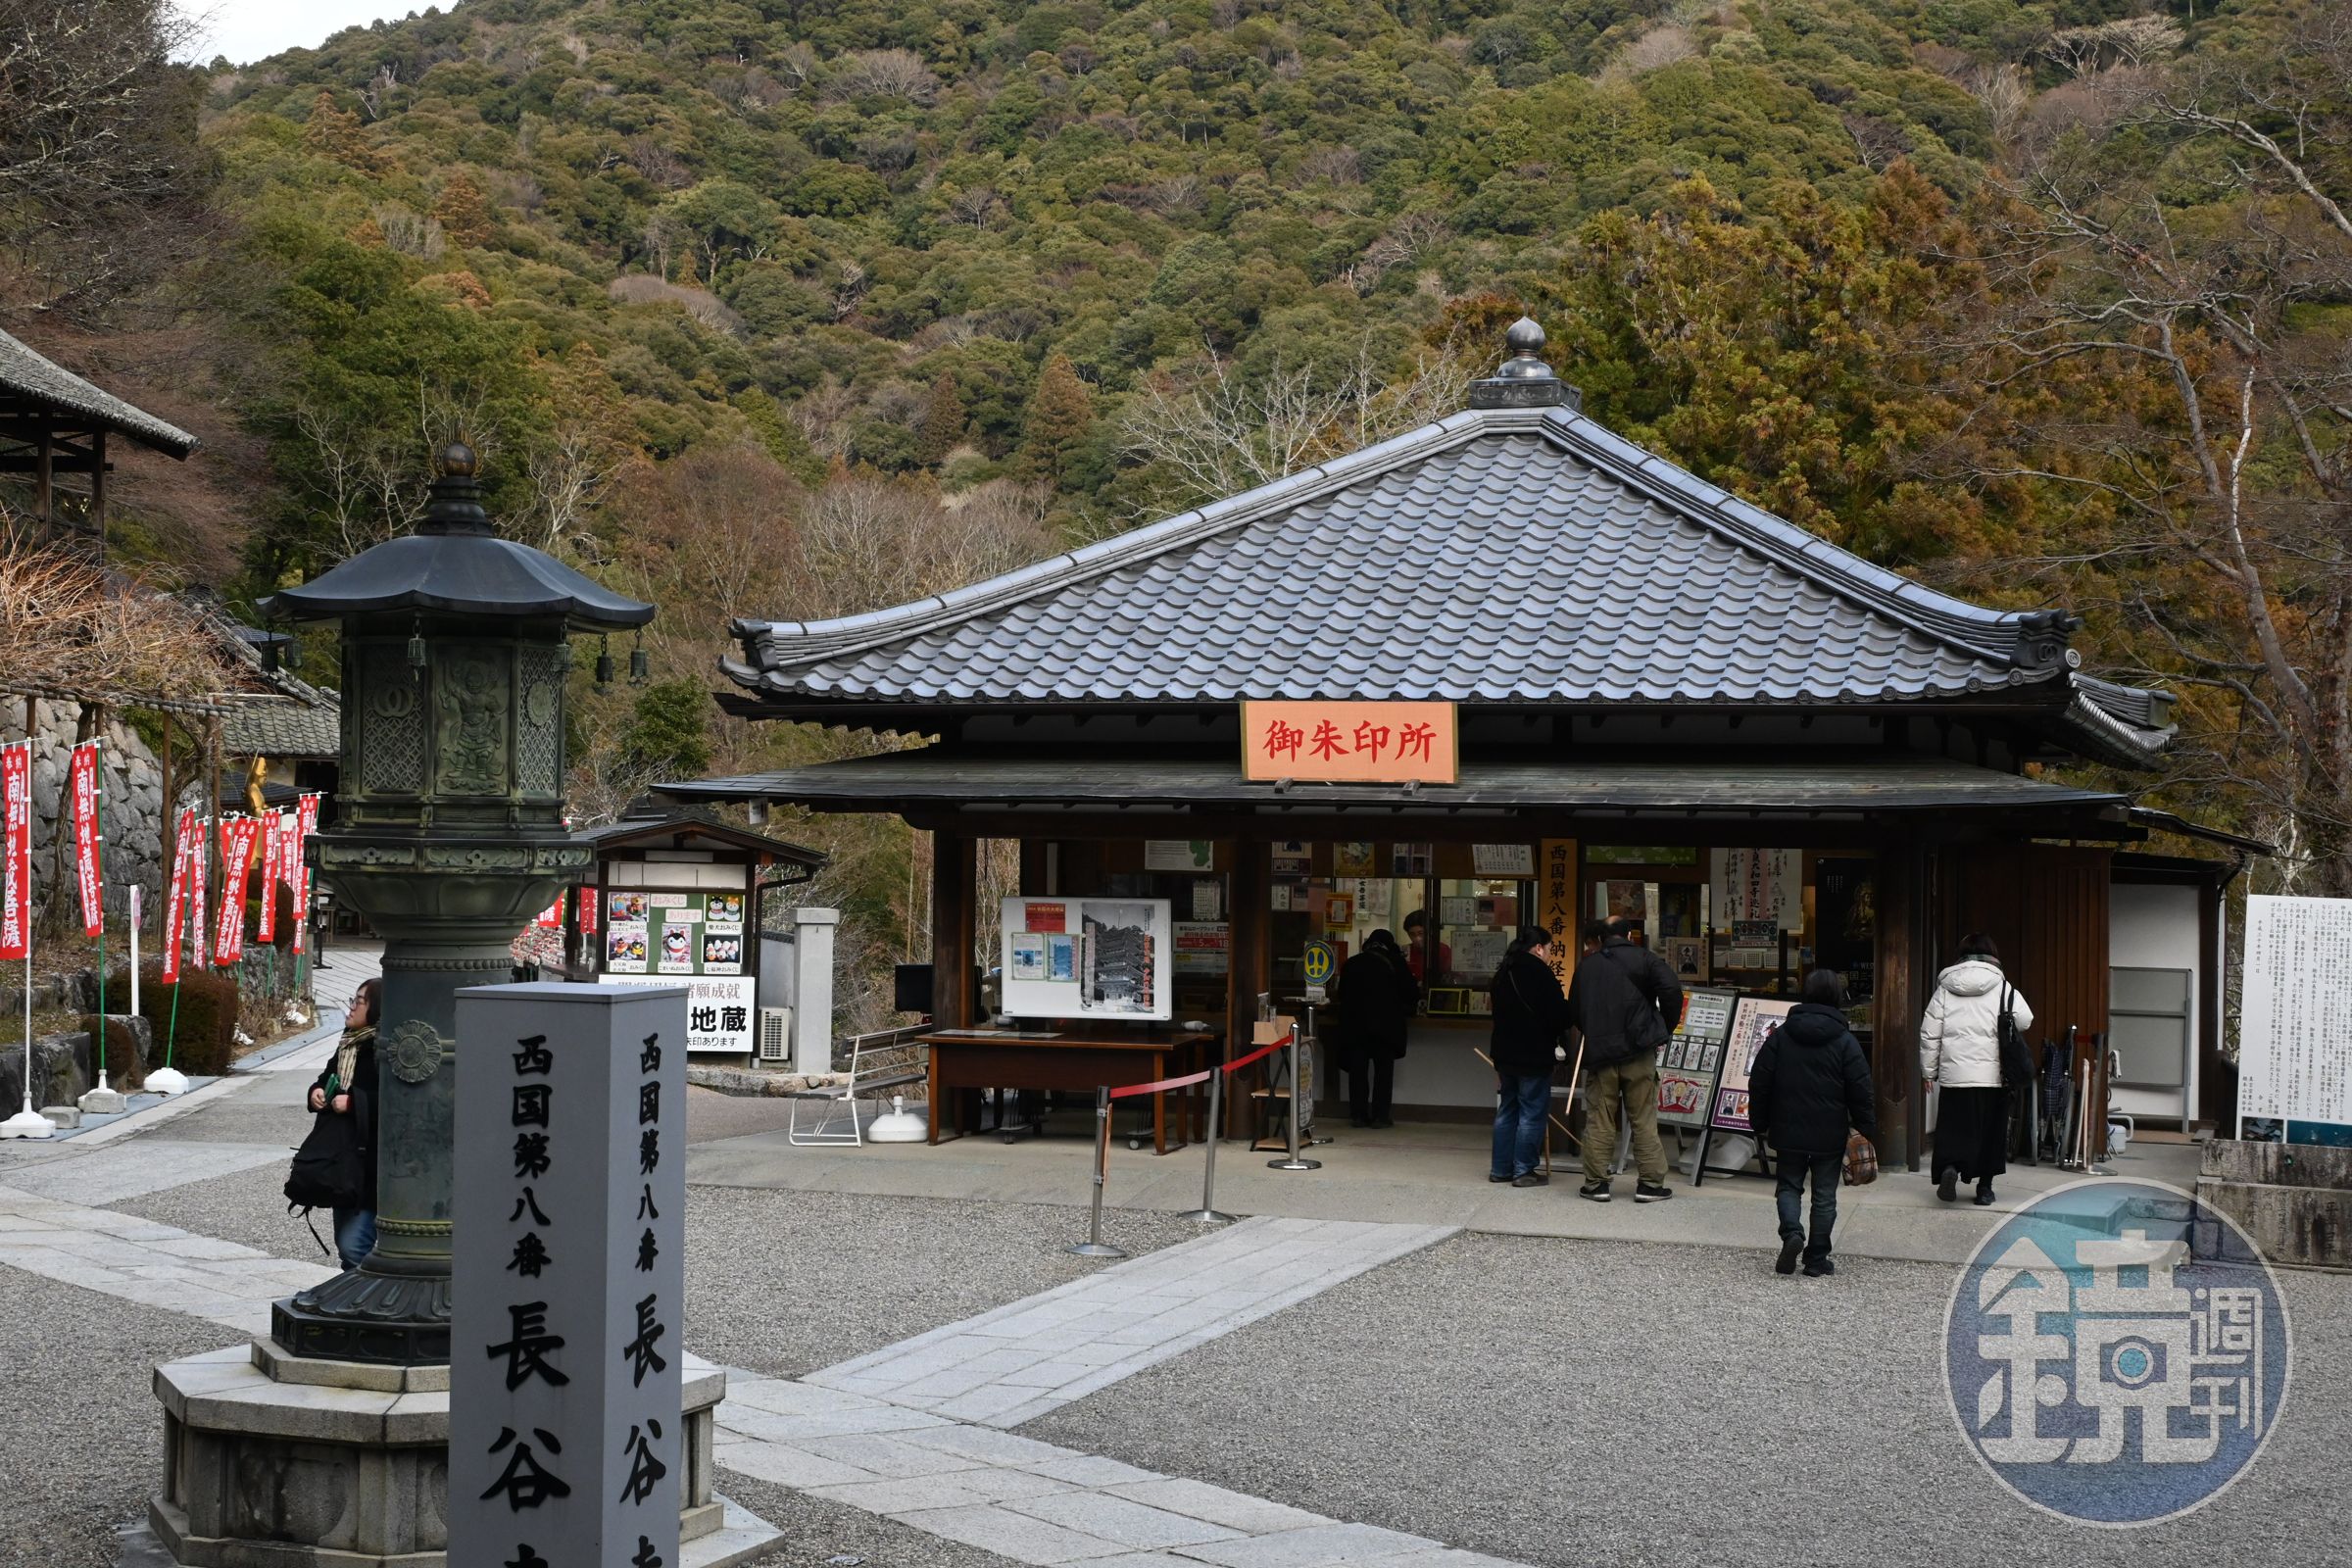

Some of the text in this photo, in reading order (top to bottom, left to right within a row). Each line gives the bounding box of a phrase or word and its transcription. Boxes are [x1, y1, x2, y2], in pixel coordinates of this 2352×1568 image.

[1263, 719, 1436, 763] 御朱印所
[653, 895, 685, 906] おみくじ
[667, 909, 702, 920] あります
[1547, 846, 1567, 987] 西国第八番納経
[691, 1005, 747, 1033] 地蔵
